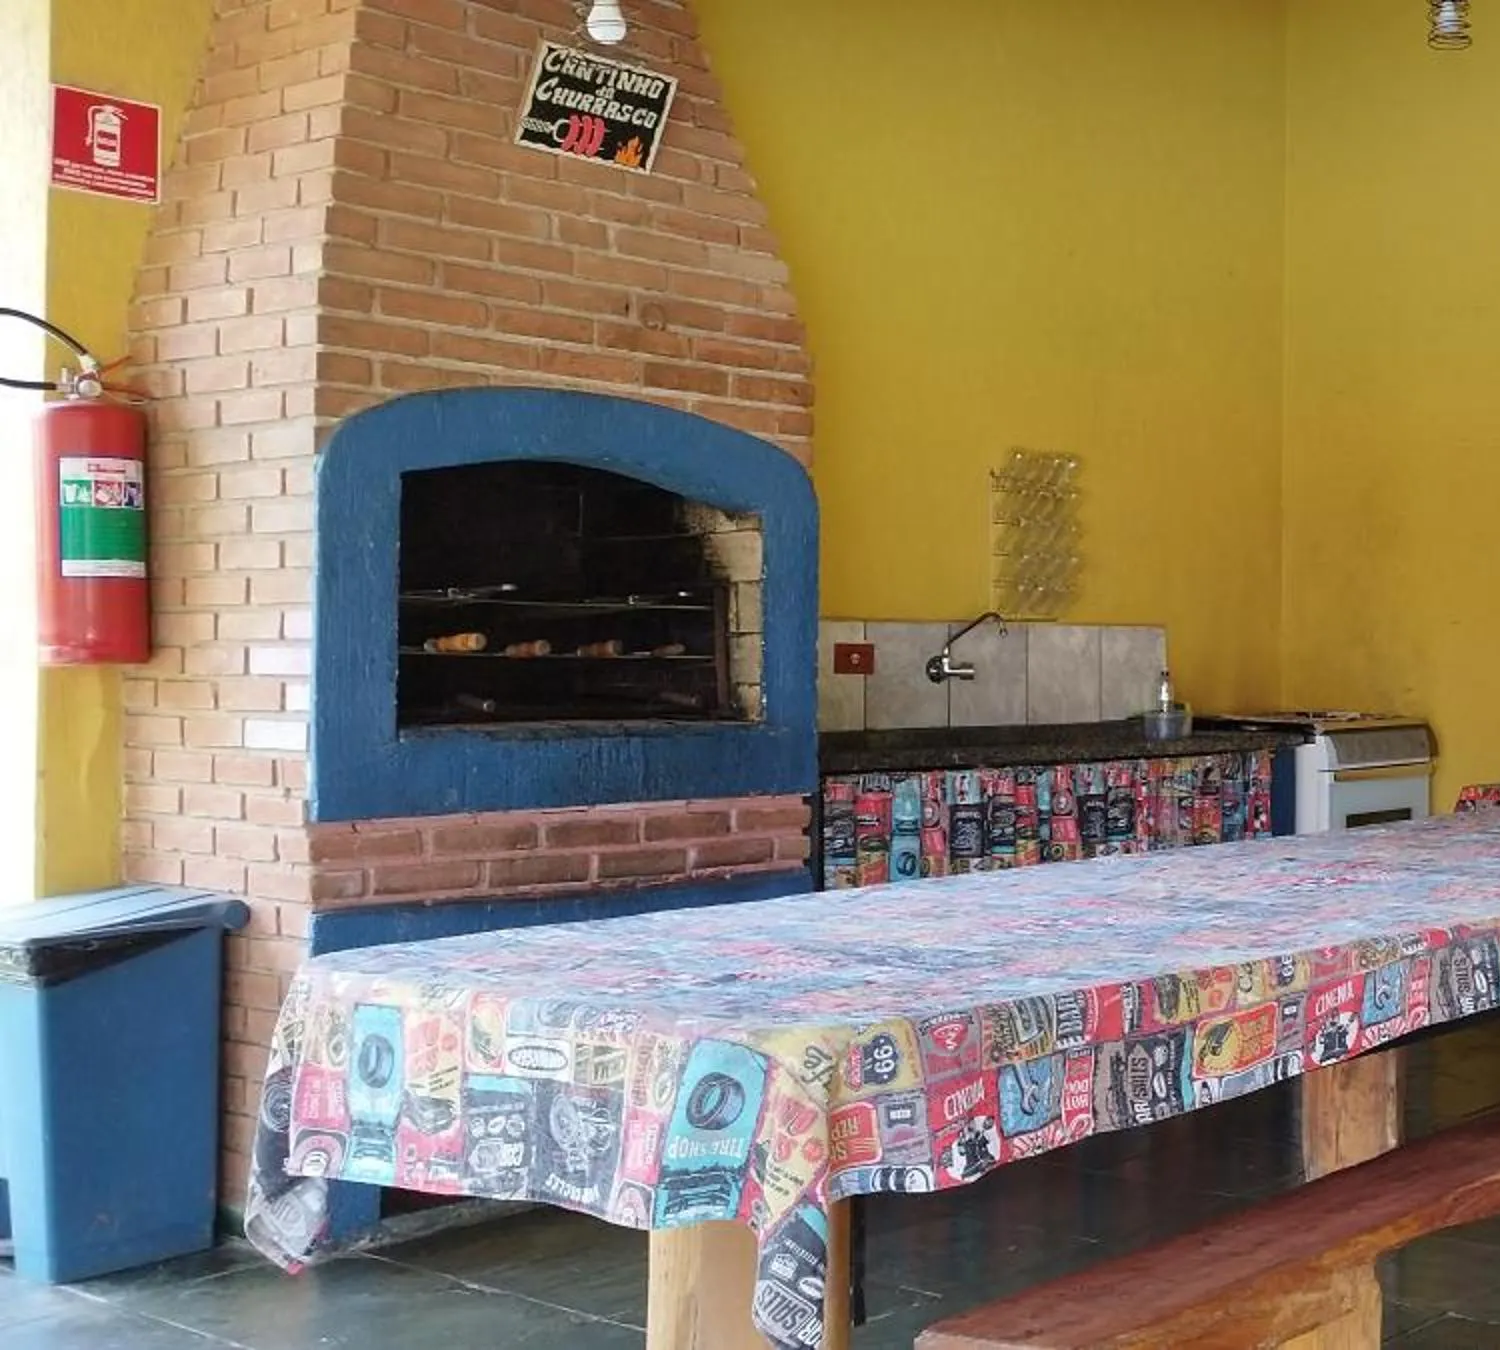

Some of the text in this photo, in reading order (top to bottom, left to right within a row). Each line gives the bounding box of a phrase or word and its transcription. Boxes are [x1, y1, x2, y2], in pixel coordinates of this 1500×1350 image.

[543, 50, 665, 100] CANTINHO
[535, 77, 658, 129] CHURRASCO
[873, 1044, 896, 1074] 66
